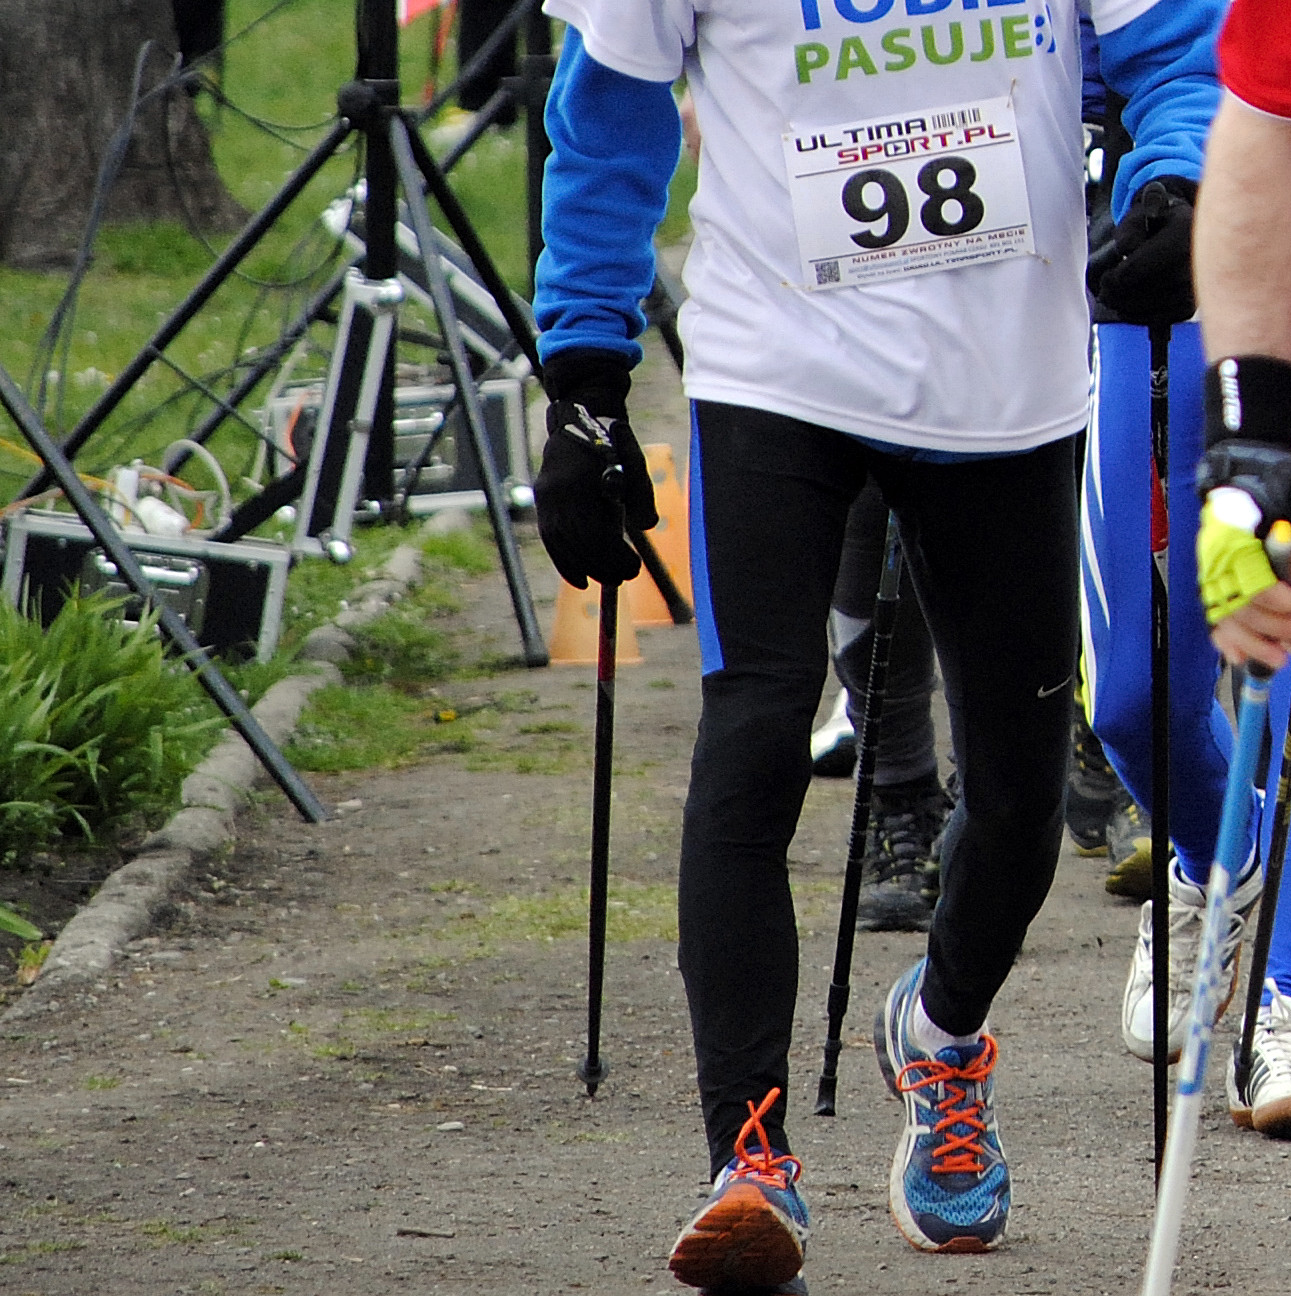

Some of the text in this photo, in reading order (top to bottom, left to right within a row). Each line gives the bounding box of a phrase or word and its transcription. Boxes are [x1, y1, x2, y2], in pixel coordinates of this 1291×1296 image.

[795, 117, 927, 152] ULTIMA
[837, 123, 1011, 165] SPORT.PL
[841, 155, 985, 249] 98
[852, 251, 896, 264] NUMER
[902, 239, 961, 256] ZWROTNY
[965, 236, 983, 245] NA
